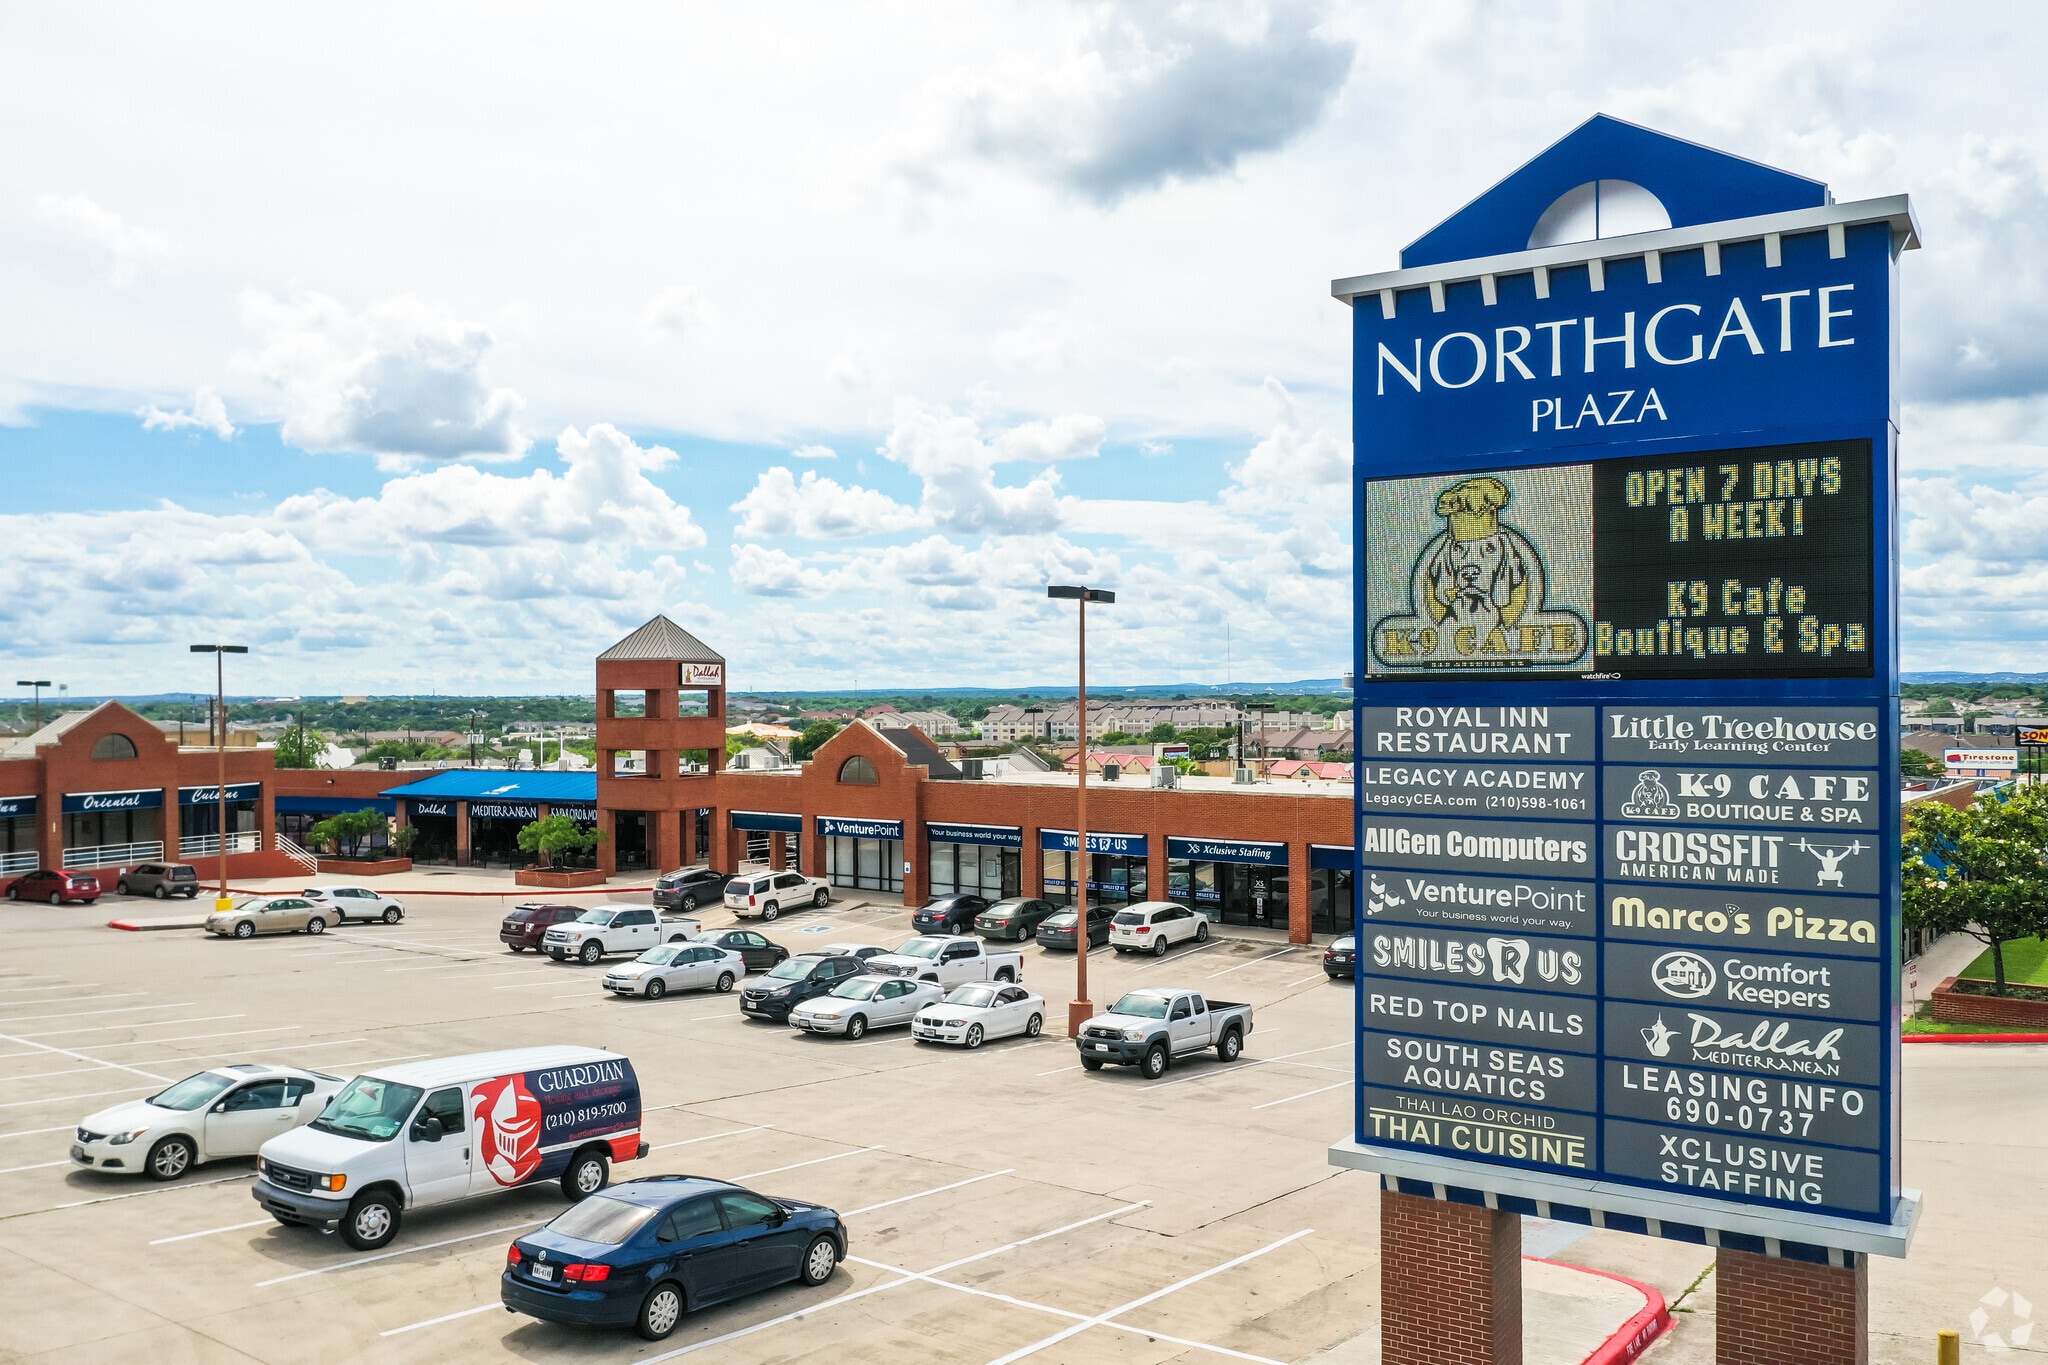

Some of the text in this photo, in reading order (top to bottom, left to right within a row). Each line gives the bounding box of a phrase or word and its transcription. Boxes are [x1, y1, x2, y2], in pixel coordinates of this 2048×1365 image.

[1376, 283, 1855, 396] NORTHGATE
[1531, 387, 1668, 433] PLAZA
[1625, 456, 1842, 508] OPEN 7 DAYS
[1669, 498, 1805, 542] A WEEK!
[1667, 576, 1806, 618] K9 Cafe
[1453, 623, 1579, 656] CAFE
[1595, 614, 1866, 658] Boutique & Spa
[693, 664, 720, 678] Dallah
[1581, 672, 1611, 680] watchfire
[1396, 706, 1548, 728] ROYAL INN
[1609, 714, 1877, 742] Little Treehouse
[1377, 732, 1572, 754] RESTAURANT
[1648, 740, 1832, 755] Early Learning Center
[1365, 767, 1585, 790] LEGACY ACADEMY
[1676, 773, 1870, 802] K-9 CAFE
[83, 793, 140, 810] Oriental
[418, 803, 447, 816] Dallah
[471, 804, 538, 819] MEDITERRANEAN
[1365, 792, 1586, 811] LegacyCEA.com (210)598-1061
[1644, 807, 1677, 816] CAFE
[1686, 803, 1863, 824] BOUTIQUE & SPA
[836, 821, 899, 837] VenturePoint
[931, 828, 945, 836] Your
[946, 828, 973, 838] business
[974, 831, 992, 840] world
[992, 834, 1007, 843] your
[1203, 844, 1238, 857] Xclusive
[1239, 846, 1272, 860] Staffing
[1364, 827, 1588, 864] AllGen Computers
[1616, 830, 1784, 868] CROSSFIT
[1619, 862, 1779, 884] AMERICAN MADE
[1405, 878, 1586, 913] VenturePoint
[1416, 908, 1574, 930] Your business world your way.
[1766, 906, 1876, 944] Pizza
[1373, 934, 1486, 977] SMILES
[1537, 949, 1582, 986] US
[1723, 958, 1831, 987] Comfort
[1727, 980, 1831, 1010] Keepers
[1370, 993, 1584, 1036] RED TOP NAILS
[1687, 1012, 1844, 1061] Dallah
[1386, 1037, 1565, 1079] SOUTH SEAS
[1692, 1048, 1840, 1077] MEDITERRANEAN
[539, 1062, 622, 1092] GUARDIAN
[1403, 1064, 1546, 1101] AQUATICS
[1622, 1064, 1864, 1116] LEASING INFO
[545, 1102, 627, 1131] (210) 819-5700
[1396, 1095, 1556, 1130] THAI LAO ORCHID
[1666, 1096, 1815, 1137] 690-0737
[1369, 1112, 1586, 1169] THAI CUISINE
[1659, 1134, 1824, 1179] XCLUSIVE
[1661, 1161, 1823, 1205] STAFFING
